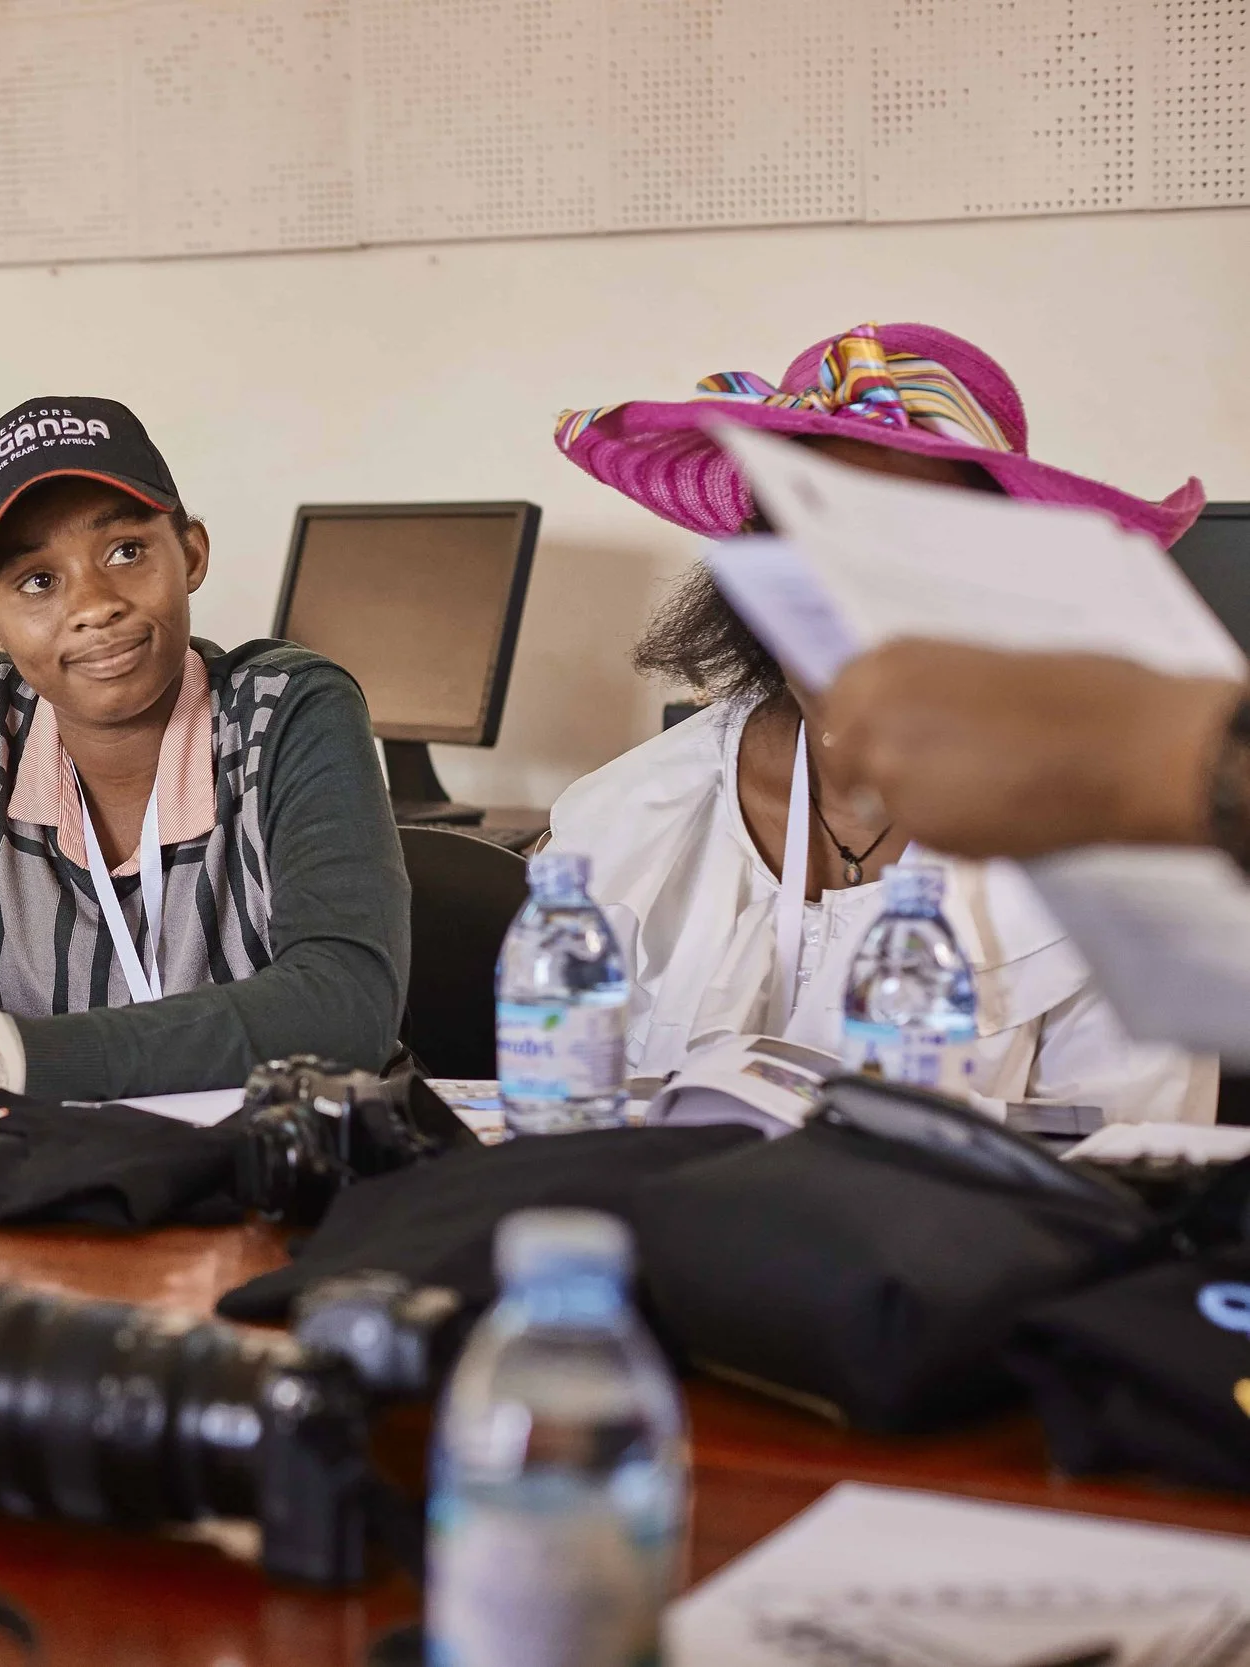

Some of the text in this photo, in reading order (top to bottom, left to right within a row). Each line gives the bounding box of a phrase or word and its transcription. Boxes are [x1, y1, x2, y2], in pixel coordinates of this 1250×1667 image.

[0, 409, 72, 436] EXPLORE
[10, 443, 39, 461] PEARL
[42, 438, 57, 447] OF
[59, 437, 96, 446] AFRICA
